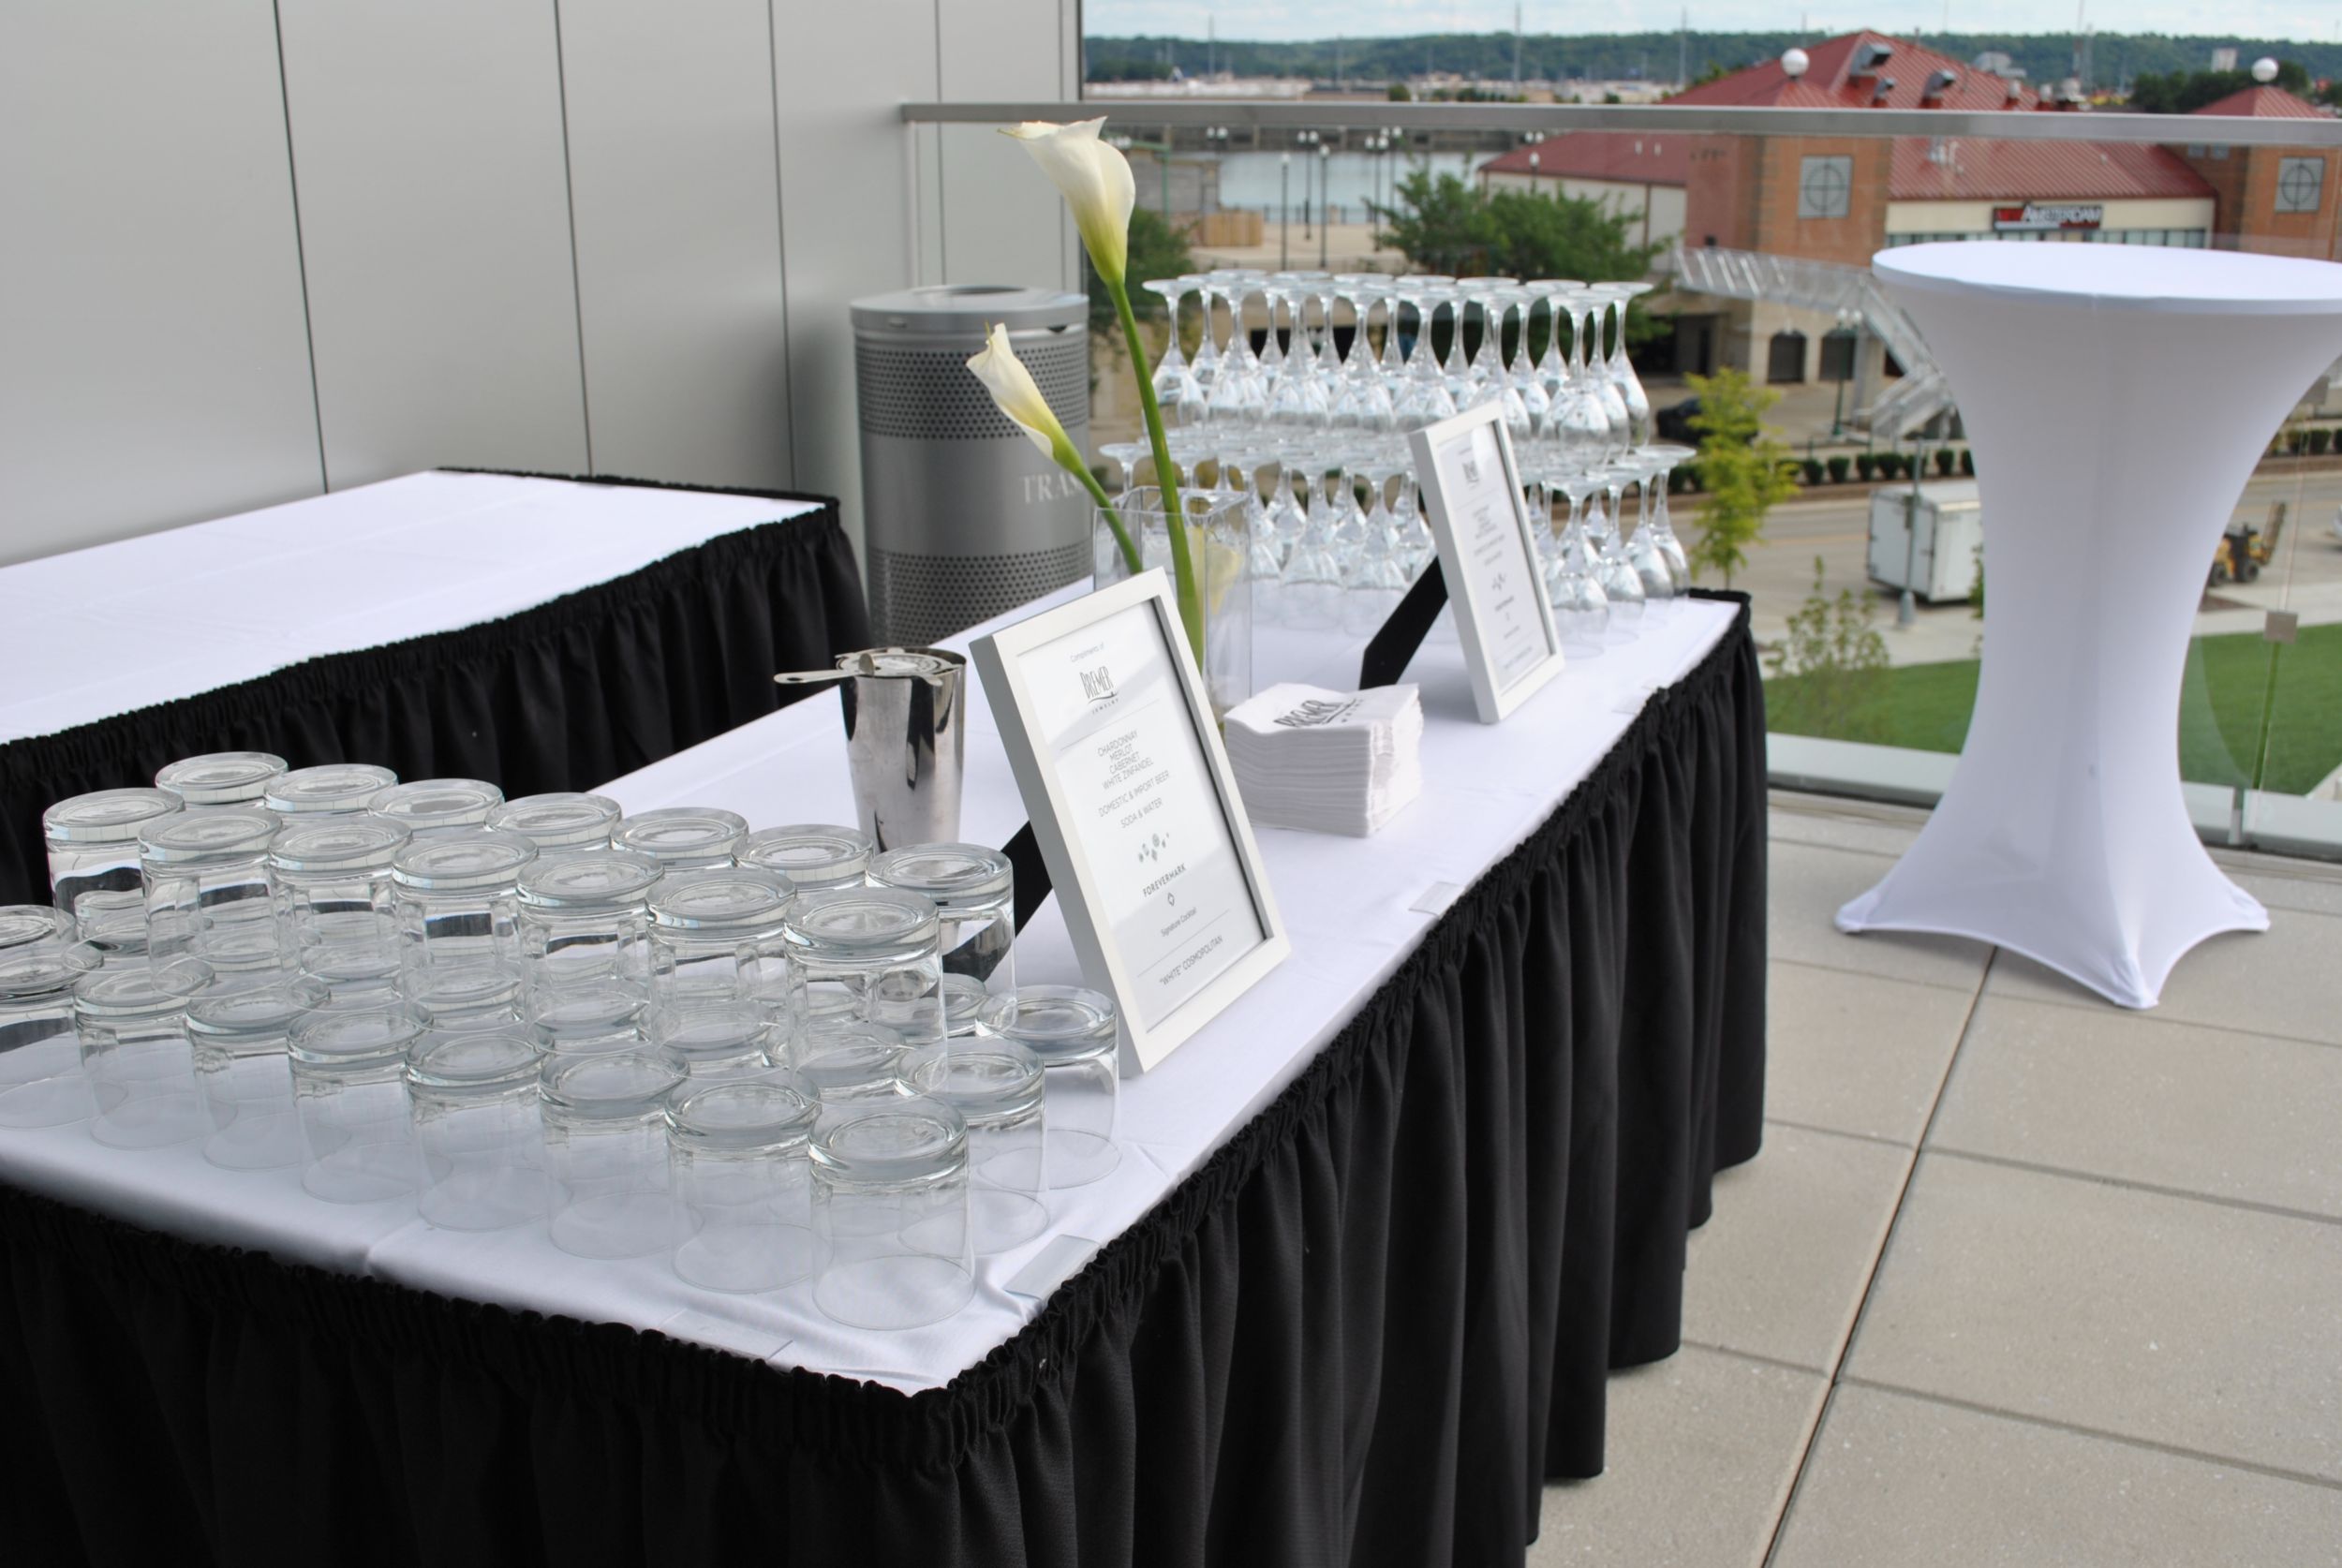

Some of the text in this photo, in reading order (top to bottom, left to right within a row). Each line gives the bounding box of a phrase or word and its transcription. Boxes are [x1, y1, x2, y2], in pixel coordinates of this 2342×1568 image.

[1019, 471, 1083, 503] TRAS
[1079, 665, 1115, 700] BREMER
[1097, 730, 1138, 757] CHARDONNAY
[1110, 743, 1134, 762] MERLOT
[1102, 757, 1154, 790] WHITE ZINFANDEL
[1109, 750, 1140, 776] CABERNET
[1098, 793, 1129, 818] DOMESTIC
[1134, 777, 1155, 796] IMPORT
[1153, 769, 1170, 786] BEER
[1119, 812, 1138, 829] SODA
[1143, 797, 1164, 815] WATER
[1142, 862, 1187, 898] FOREVERMARK
[1160, 906, 1198, 938] Signature Cocktail
[1181, 934, 1223, 970] COSMOPOLITAN
